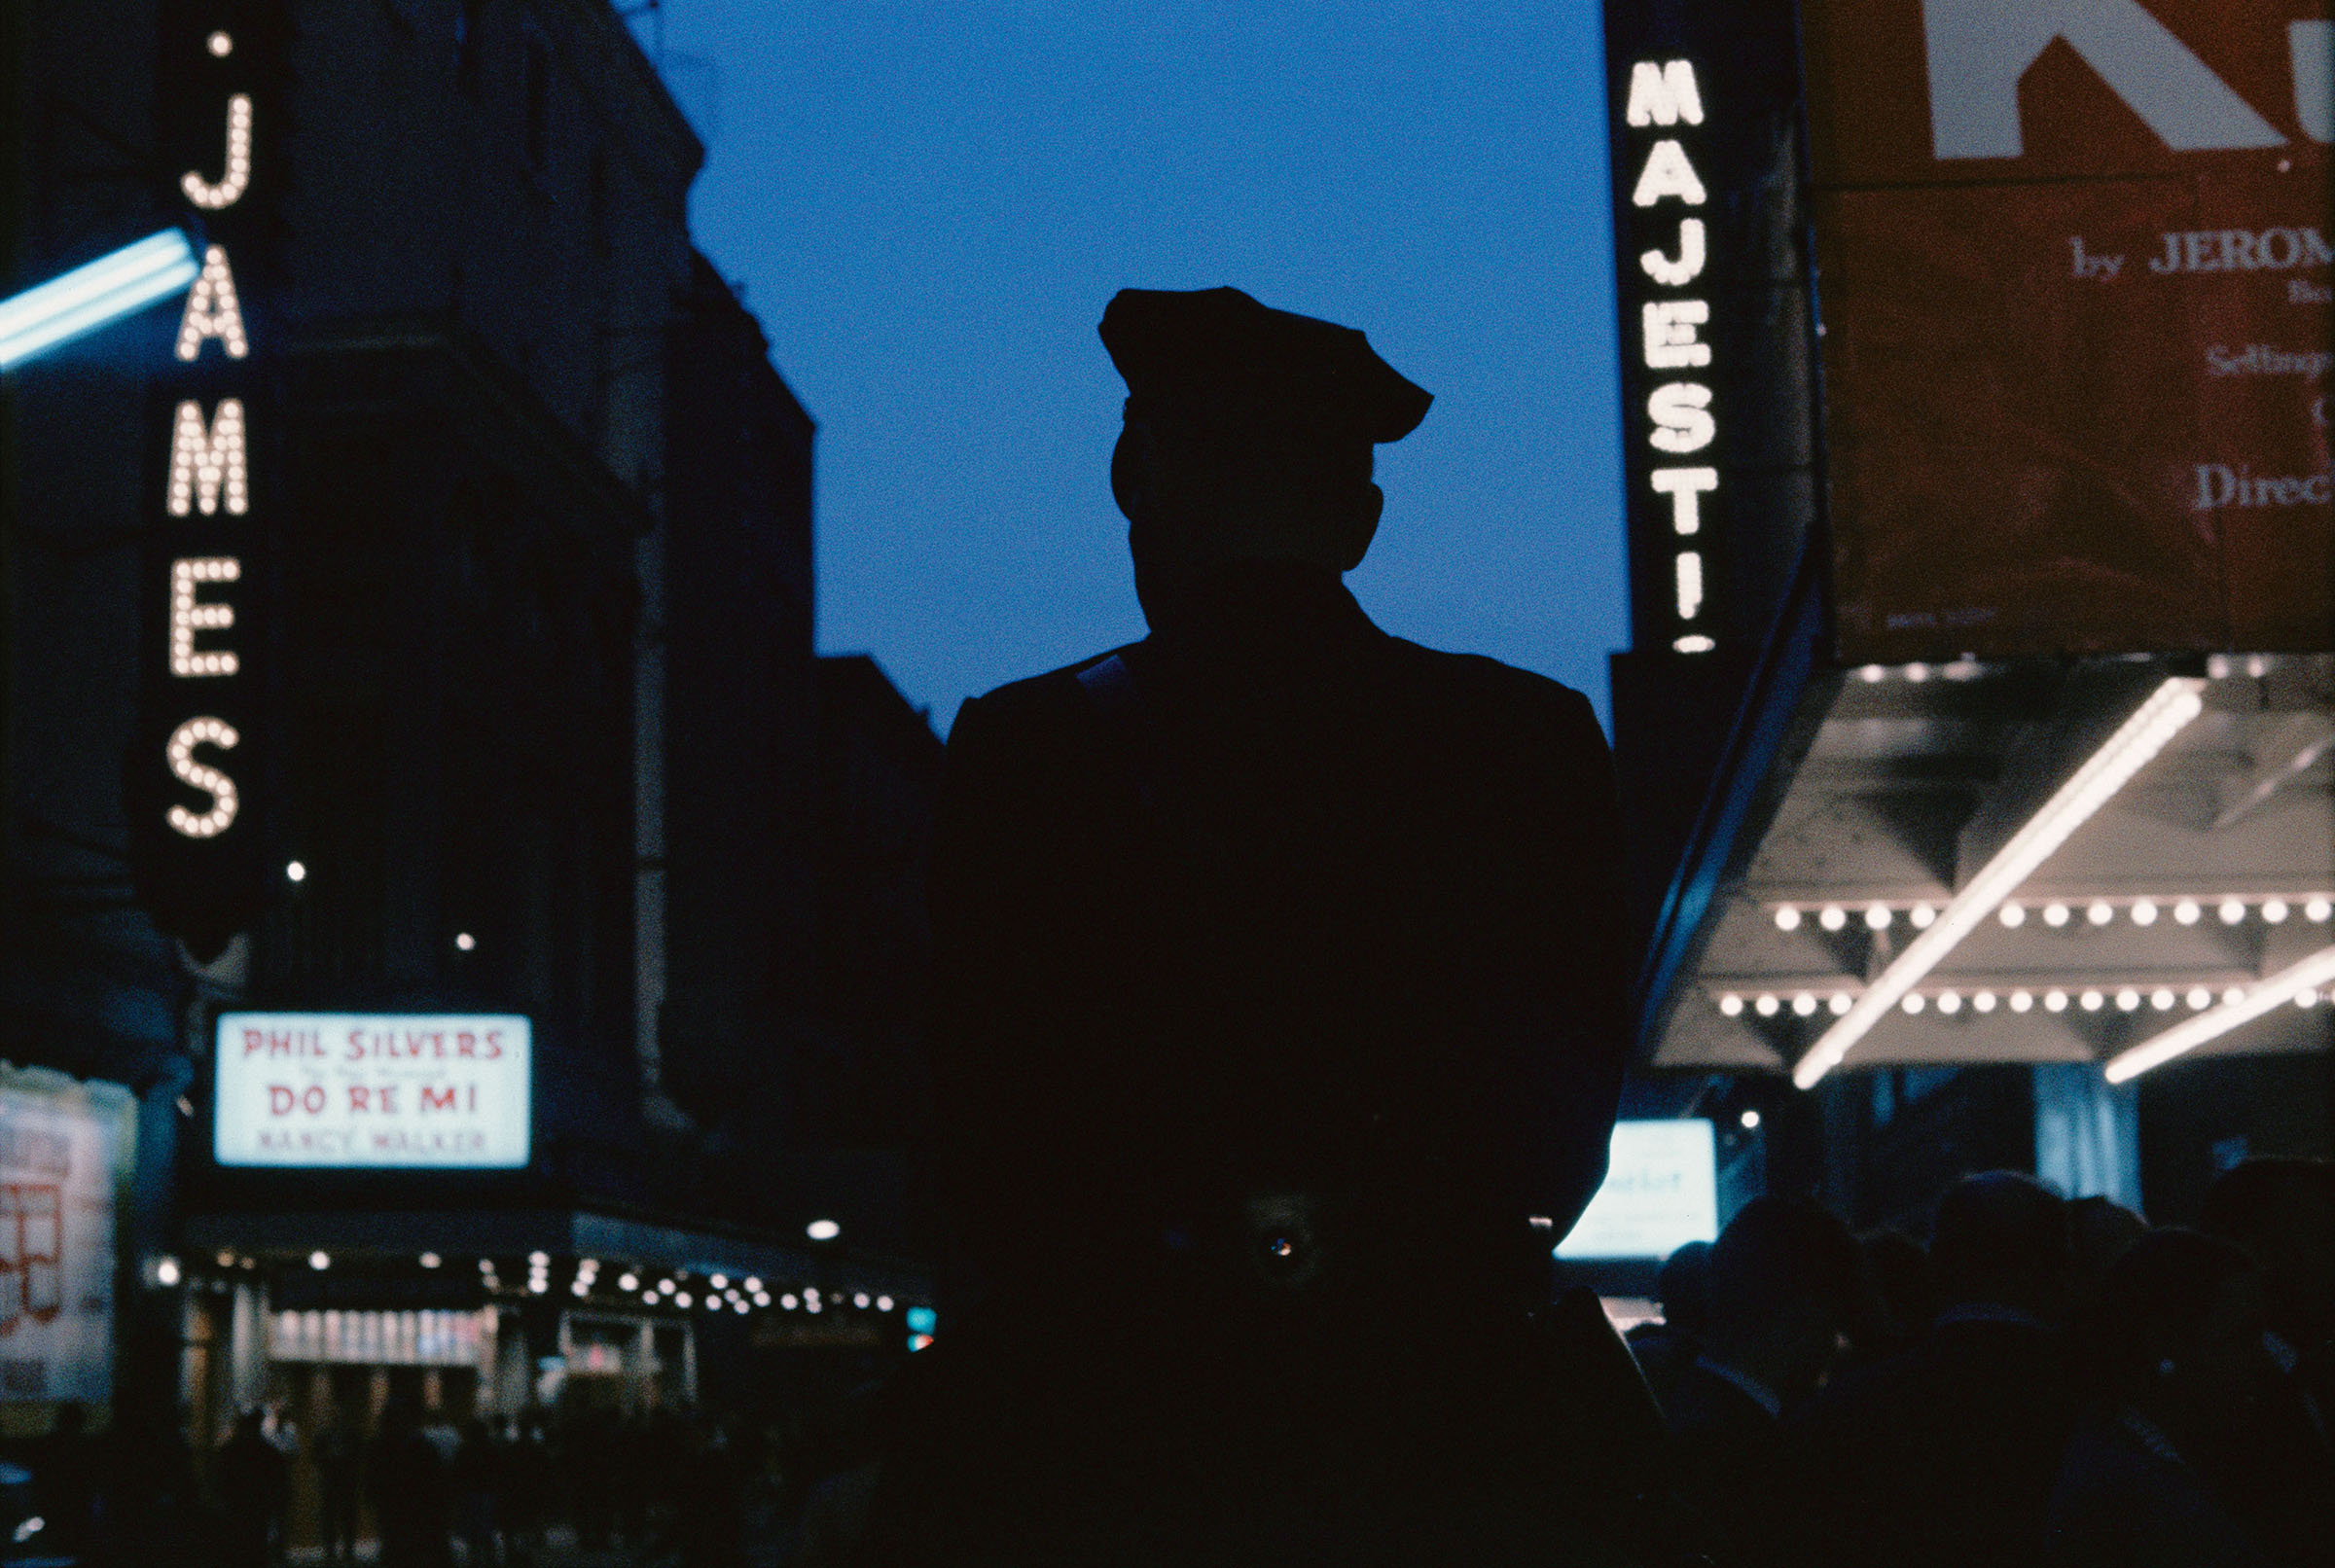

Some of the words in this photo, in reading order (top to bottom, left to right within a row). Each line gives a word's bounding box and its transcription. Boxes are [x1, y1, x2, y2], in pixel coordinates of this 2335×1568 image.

[2068, 235, 2125, 282] by
[1626, 58, 1718, 654] MAJESTI
[166, 93, 250, 837] JAMES
[242, 1028, 326, 1058] PHIL
[346, 1030, 504, 1060] SILVERS
[268, 1086, 327, 1117] DO
[347, 1086, 398, 1114] RE
[420, 1085, 478, 1114] MI
